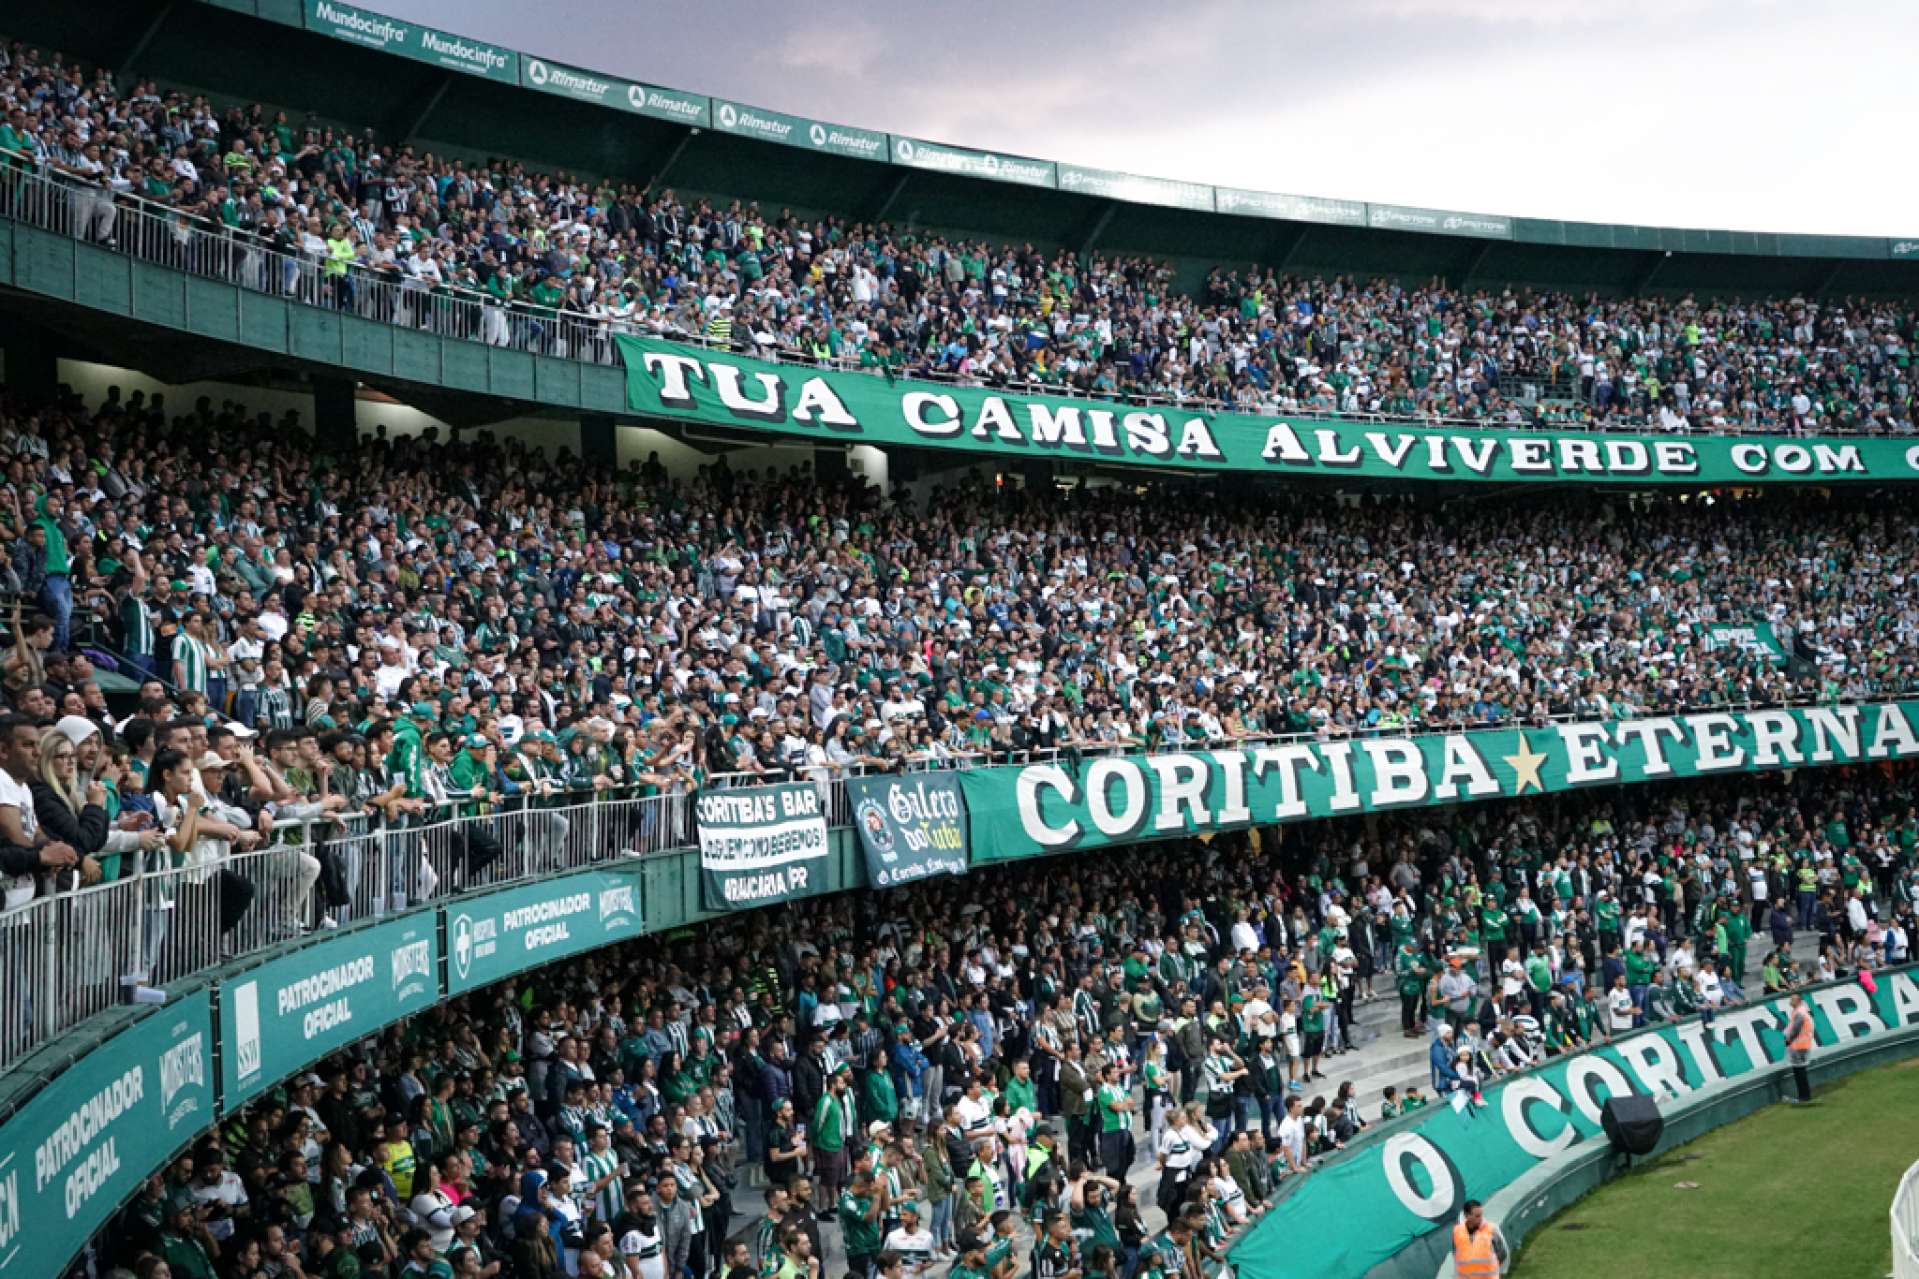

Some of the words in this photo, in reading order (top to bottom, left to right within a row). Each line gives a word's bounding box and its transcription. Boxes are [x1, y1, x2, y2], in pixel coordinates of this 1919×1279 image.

[316, 1, 404, 42] Mundocinfra
[421, 31, 505, 69] Mundocinfra
[549, 70, 610, 95] Rimatur
[647, 93, 702, 116] Rimatur
[738, 113, 793, 135] Rimatur
[828, 132, 881, 151] Rimatur
[643, 351, 860, 428] TUA
[902, 391, 1224, 459] CAMISA
[1261, 422, 1699, 474] ALVIVERDE
[1731, 443, 1867, 472] COM
[1016, 734, 1500, 846] CORITIBA
[1557, 703, 1919, 784] ETERNA
[781, 789, 818, 817] BAR
[888, 781, 958, 825] Galera
[788, 865, 808, 890] PR
[503, 892, 591, 932] PATROCINADOR
[525, 921, 570, 950] OFICIAL
[278, 955, 374, 1016] PATROCINADOR
[304, 997, 352, 1040] OFICIAL
[35, 1065, 144, 1194] PATROCINADOR
[65, 1136, 120, 1220] OFICIAL
[1382, 1131, 1455, 1219] O
